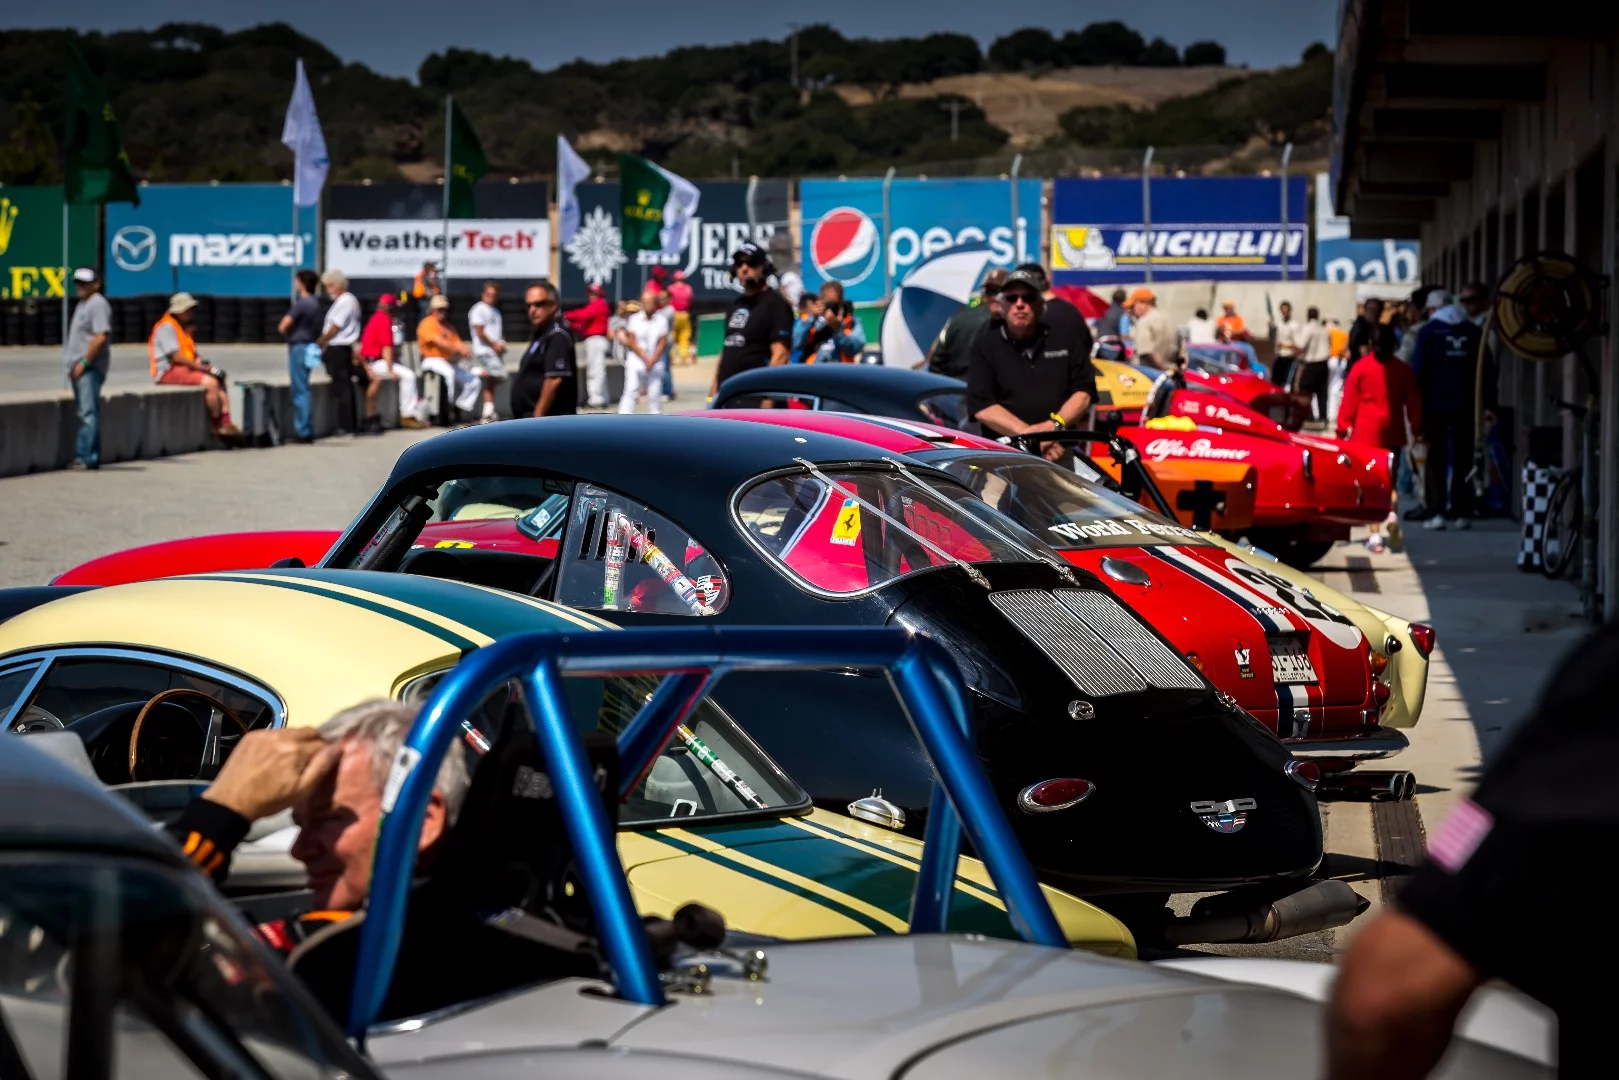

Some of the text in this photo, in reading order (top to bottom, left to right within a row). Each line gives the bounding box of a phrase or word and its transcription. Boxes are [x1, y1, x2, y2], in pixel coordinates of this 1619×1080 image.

[339, 229, 534, 250] WeatherTech
[1117, 231, 1302, 257] MICHELIN
[2, 266, 66, 298] EX
[1145, 438, 1189, 462] Alfa
[1048, 520, 1132, 540] World
